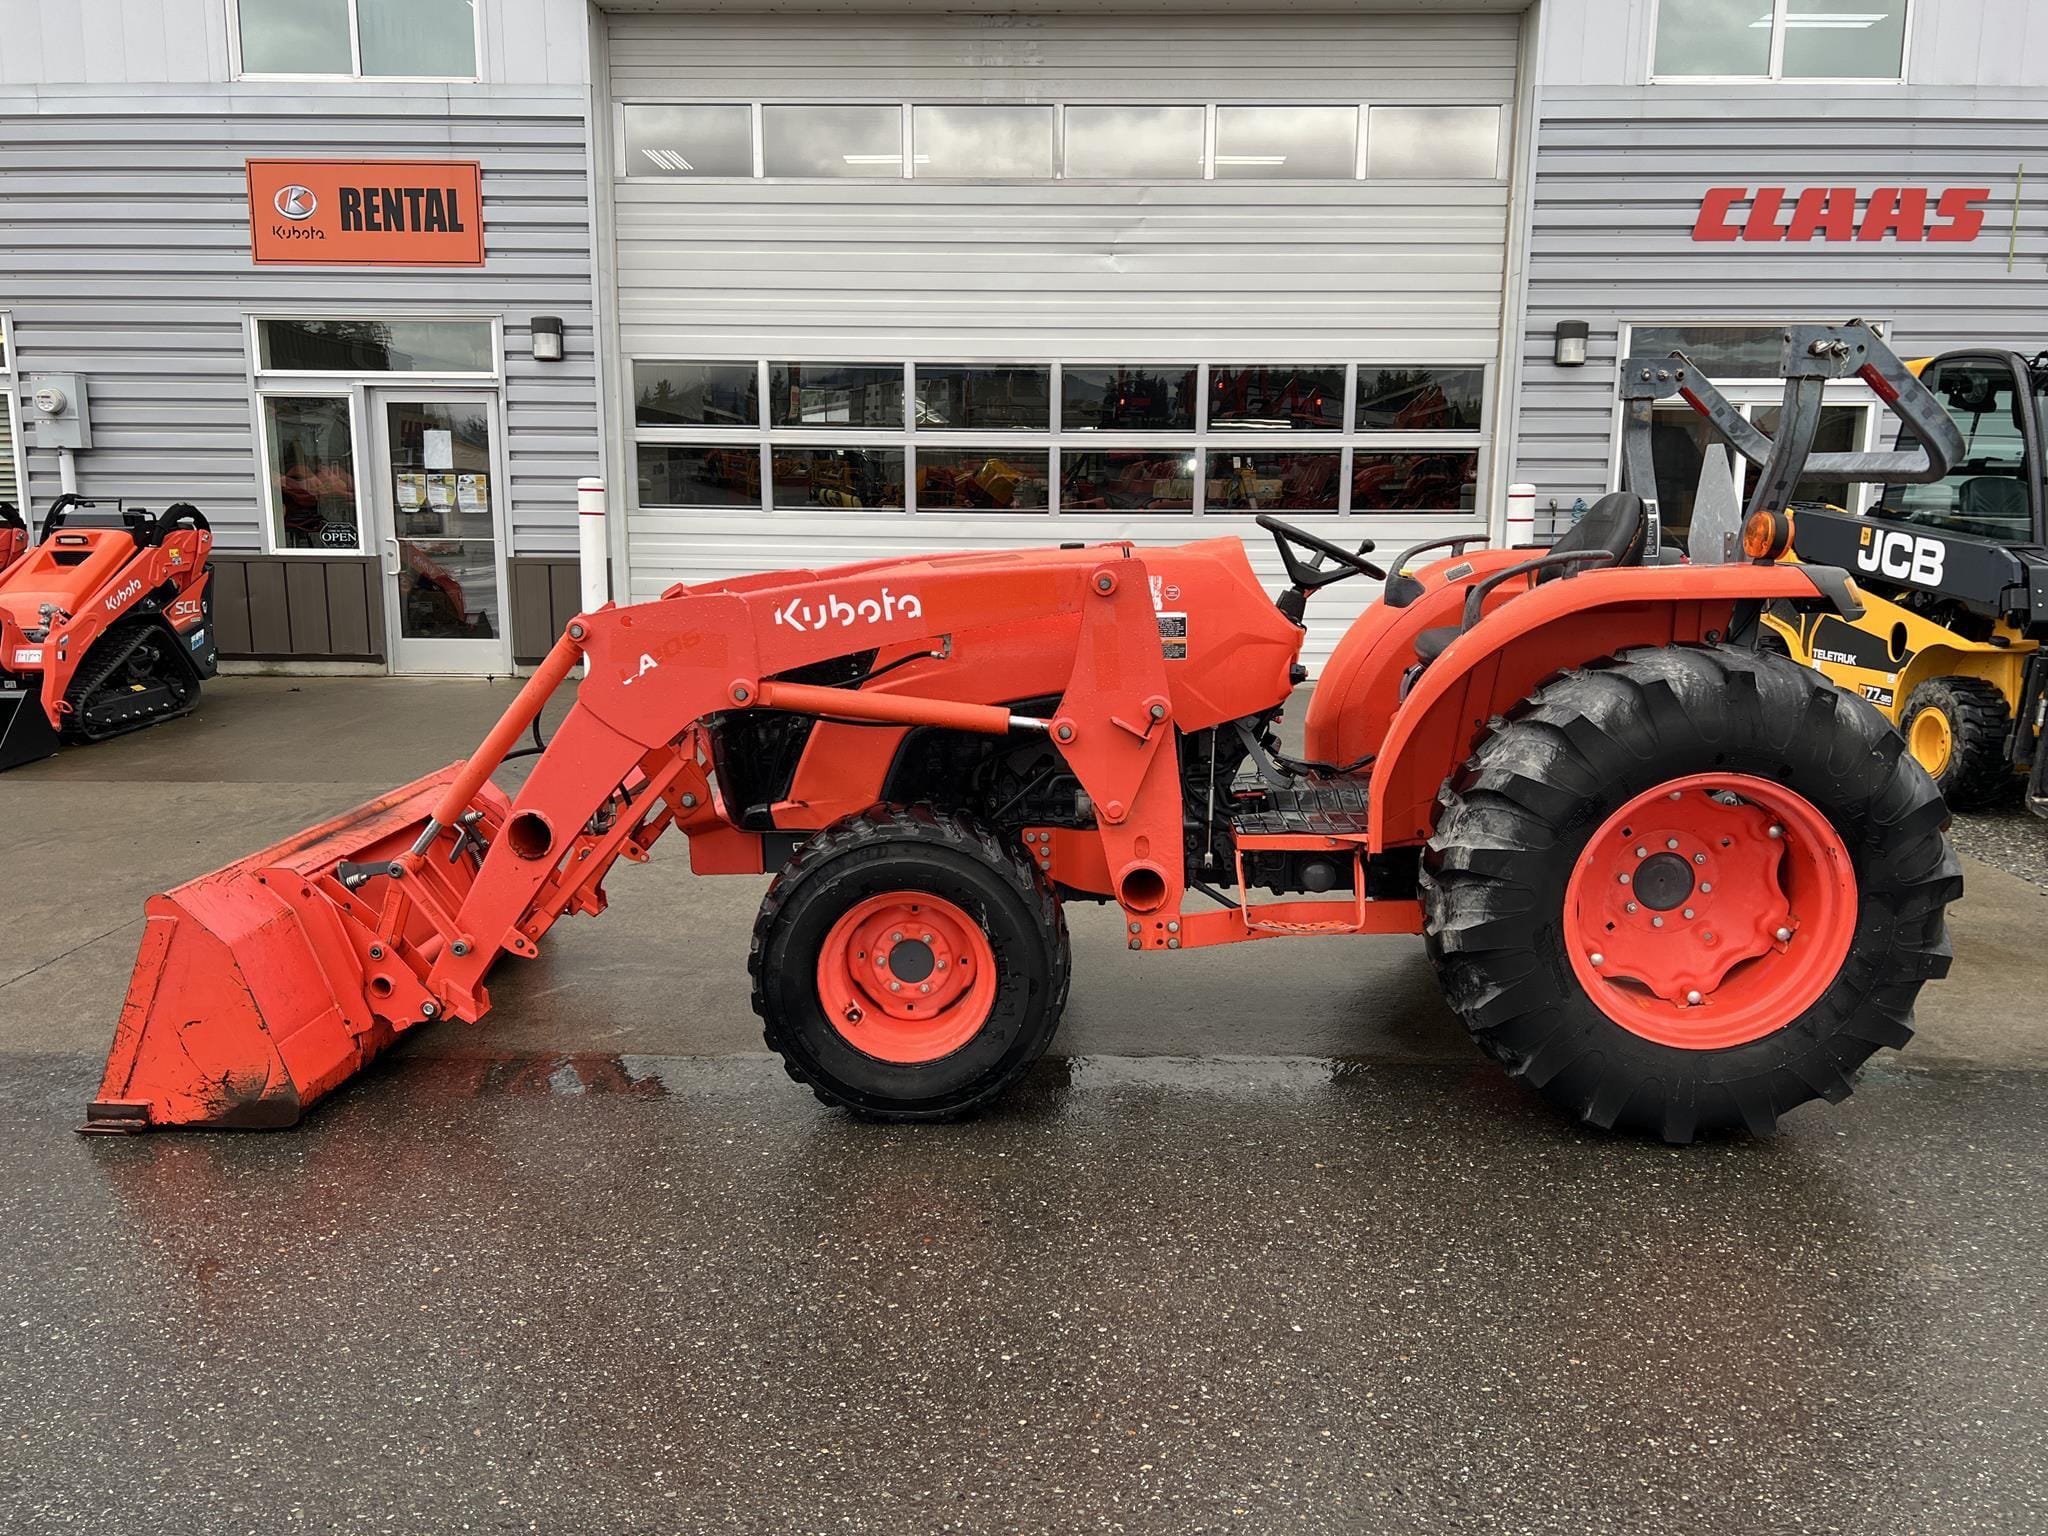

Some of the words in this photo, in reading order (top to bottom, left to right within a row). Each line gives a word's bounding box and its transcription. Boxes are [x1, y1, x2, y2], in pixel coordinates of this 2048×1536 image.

[338, 187, 464, 233] RENTAL
[1691, 187, 1991, 242] CLAAS
[272, 225, 326, 240] Kubota
[321, 532, 357, 542] OPEN
[1857, 529, 1946, 587] JCB
[105, 579, 142, 610] Kubota
[175, 600, 200, 615] SCL
[774, 587, 922, 632] Kubota
[1812, 647, 1857, 666] TELETRUK
